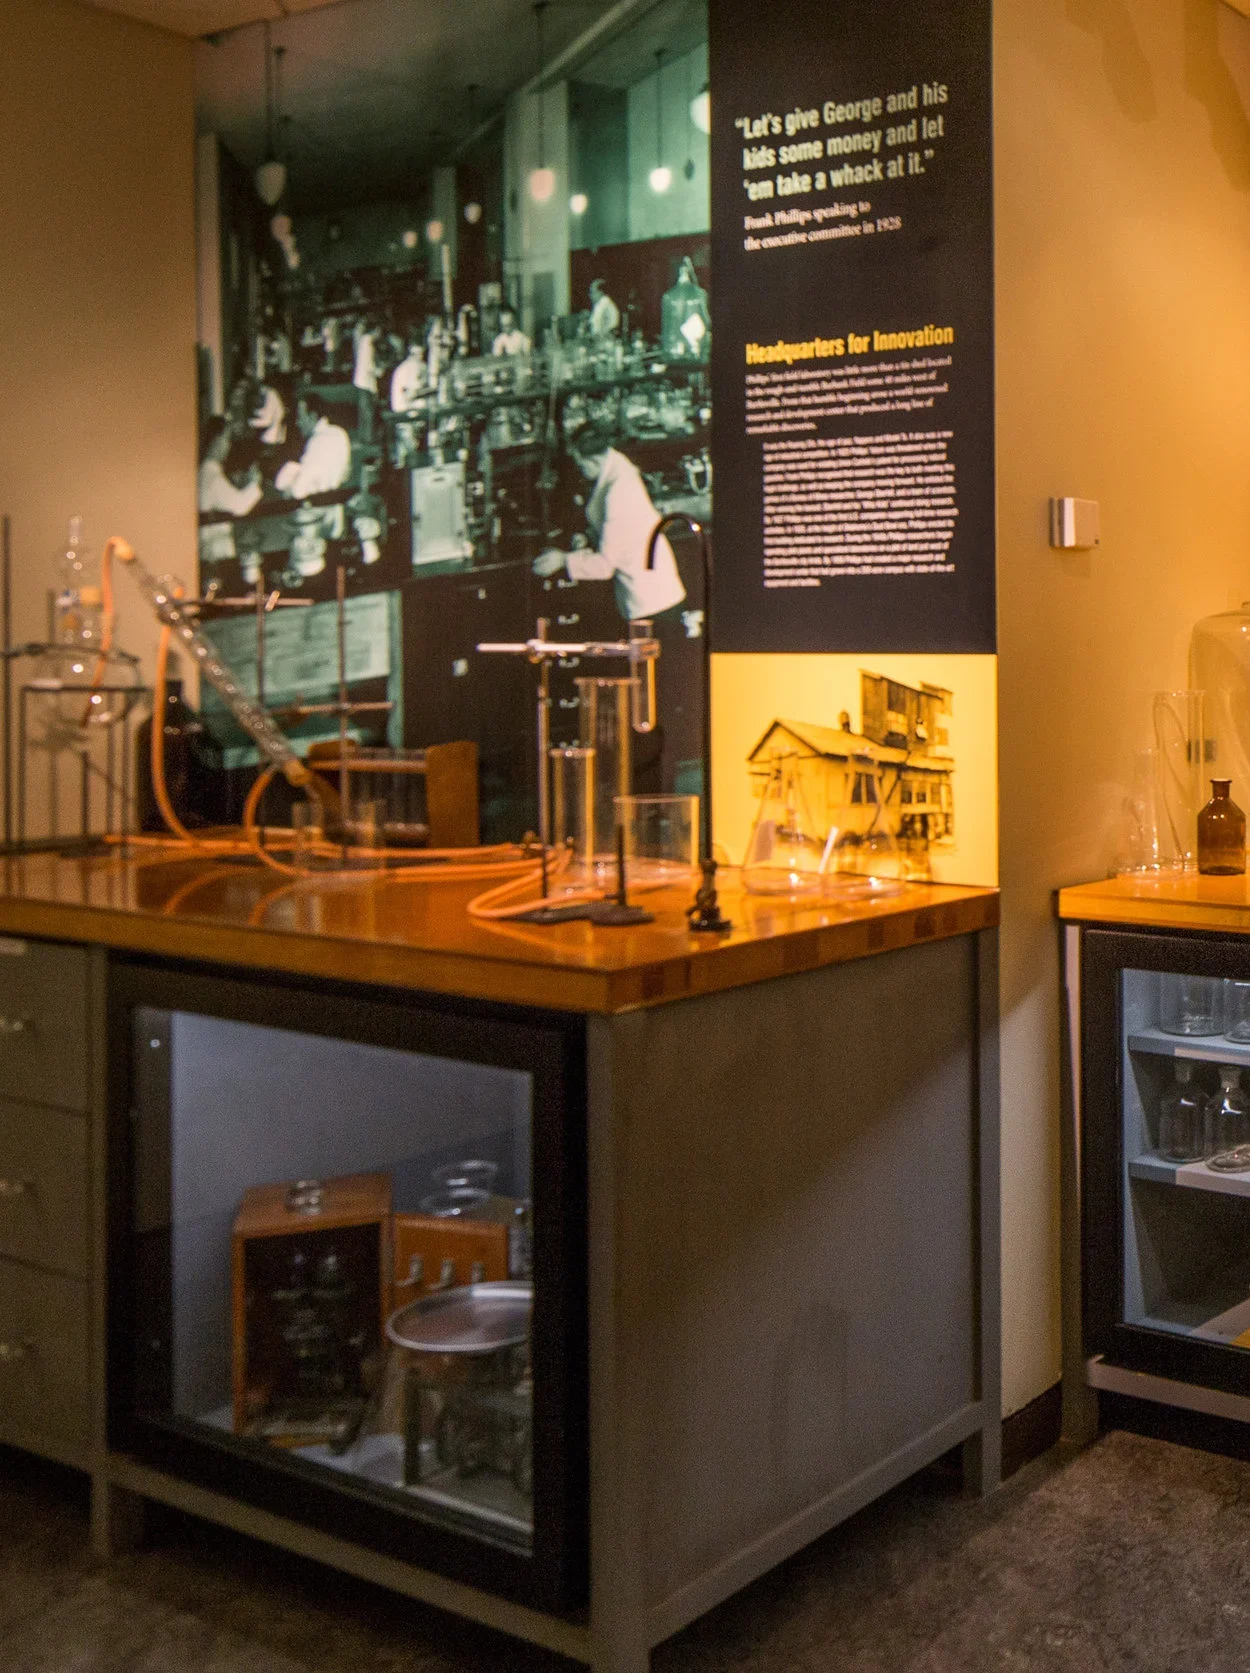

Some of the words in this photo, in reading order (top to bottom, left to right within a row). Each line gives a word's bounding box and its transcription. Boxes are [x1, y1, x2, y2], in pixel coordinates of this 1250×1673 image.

[784, 107, 819, 137] give
[822, 97, 882, 124] George
[886, 85, 917, 112] and
[922, 81, 948, 106] his
[743, 145, 776, 171] kids
[778, 140, 823, 164] some
[826, 129, 881, 156] money
[885, 118, 917, 146] and
[922, 115, 944, 139] let
[776, 170, 811, 197] take
[814, 172, 826, 190] a
[830, 157, 883, 187] whack
[886, 155, 904, 178] at
[745, 337, 845, 366] Headquarters
[847, 332, 870, 354] for
[873, 324, 953, 352] Innovation
